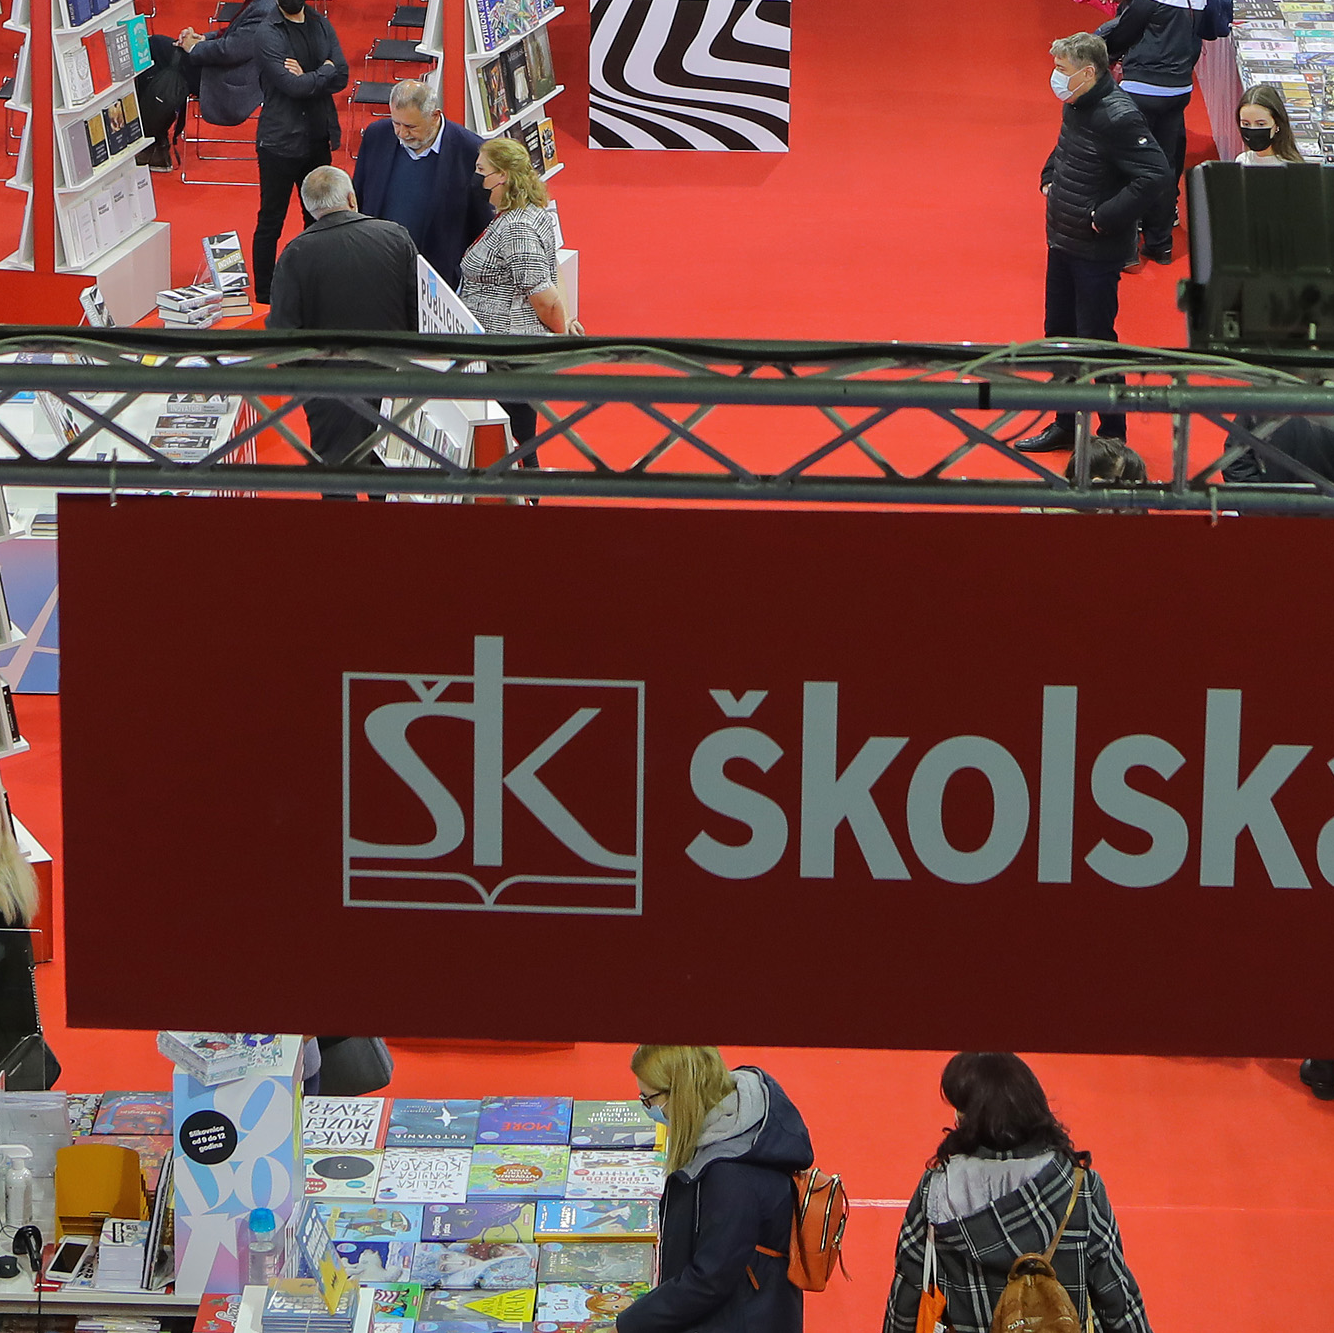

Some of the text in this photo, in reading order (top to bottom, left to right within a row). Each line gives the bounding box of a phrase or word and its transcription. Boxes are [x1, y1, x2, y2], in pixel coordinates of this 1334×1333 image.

[478, 8, 491, 45] NOBILO
[217, 251, 243, 270] INOVATORI
[170, 403, 202, 413] INOVATORI
[305, 1116, 374, 1131] MUZEJ
[501, 1121, 553, 1132] MORE
[188, 1124, 225, 1138] Slikovnice
[393, 1131, 467, 1142] PUTOVANJA
[192, 1136, 201, 1145] od
[207, 1134, 218, 1142] do
[218, 1132, 226, 1140] 12
[198, 1142, 223, 1153] godina
